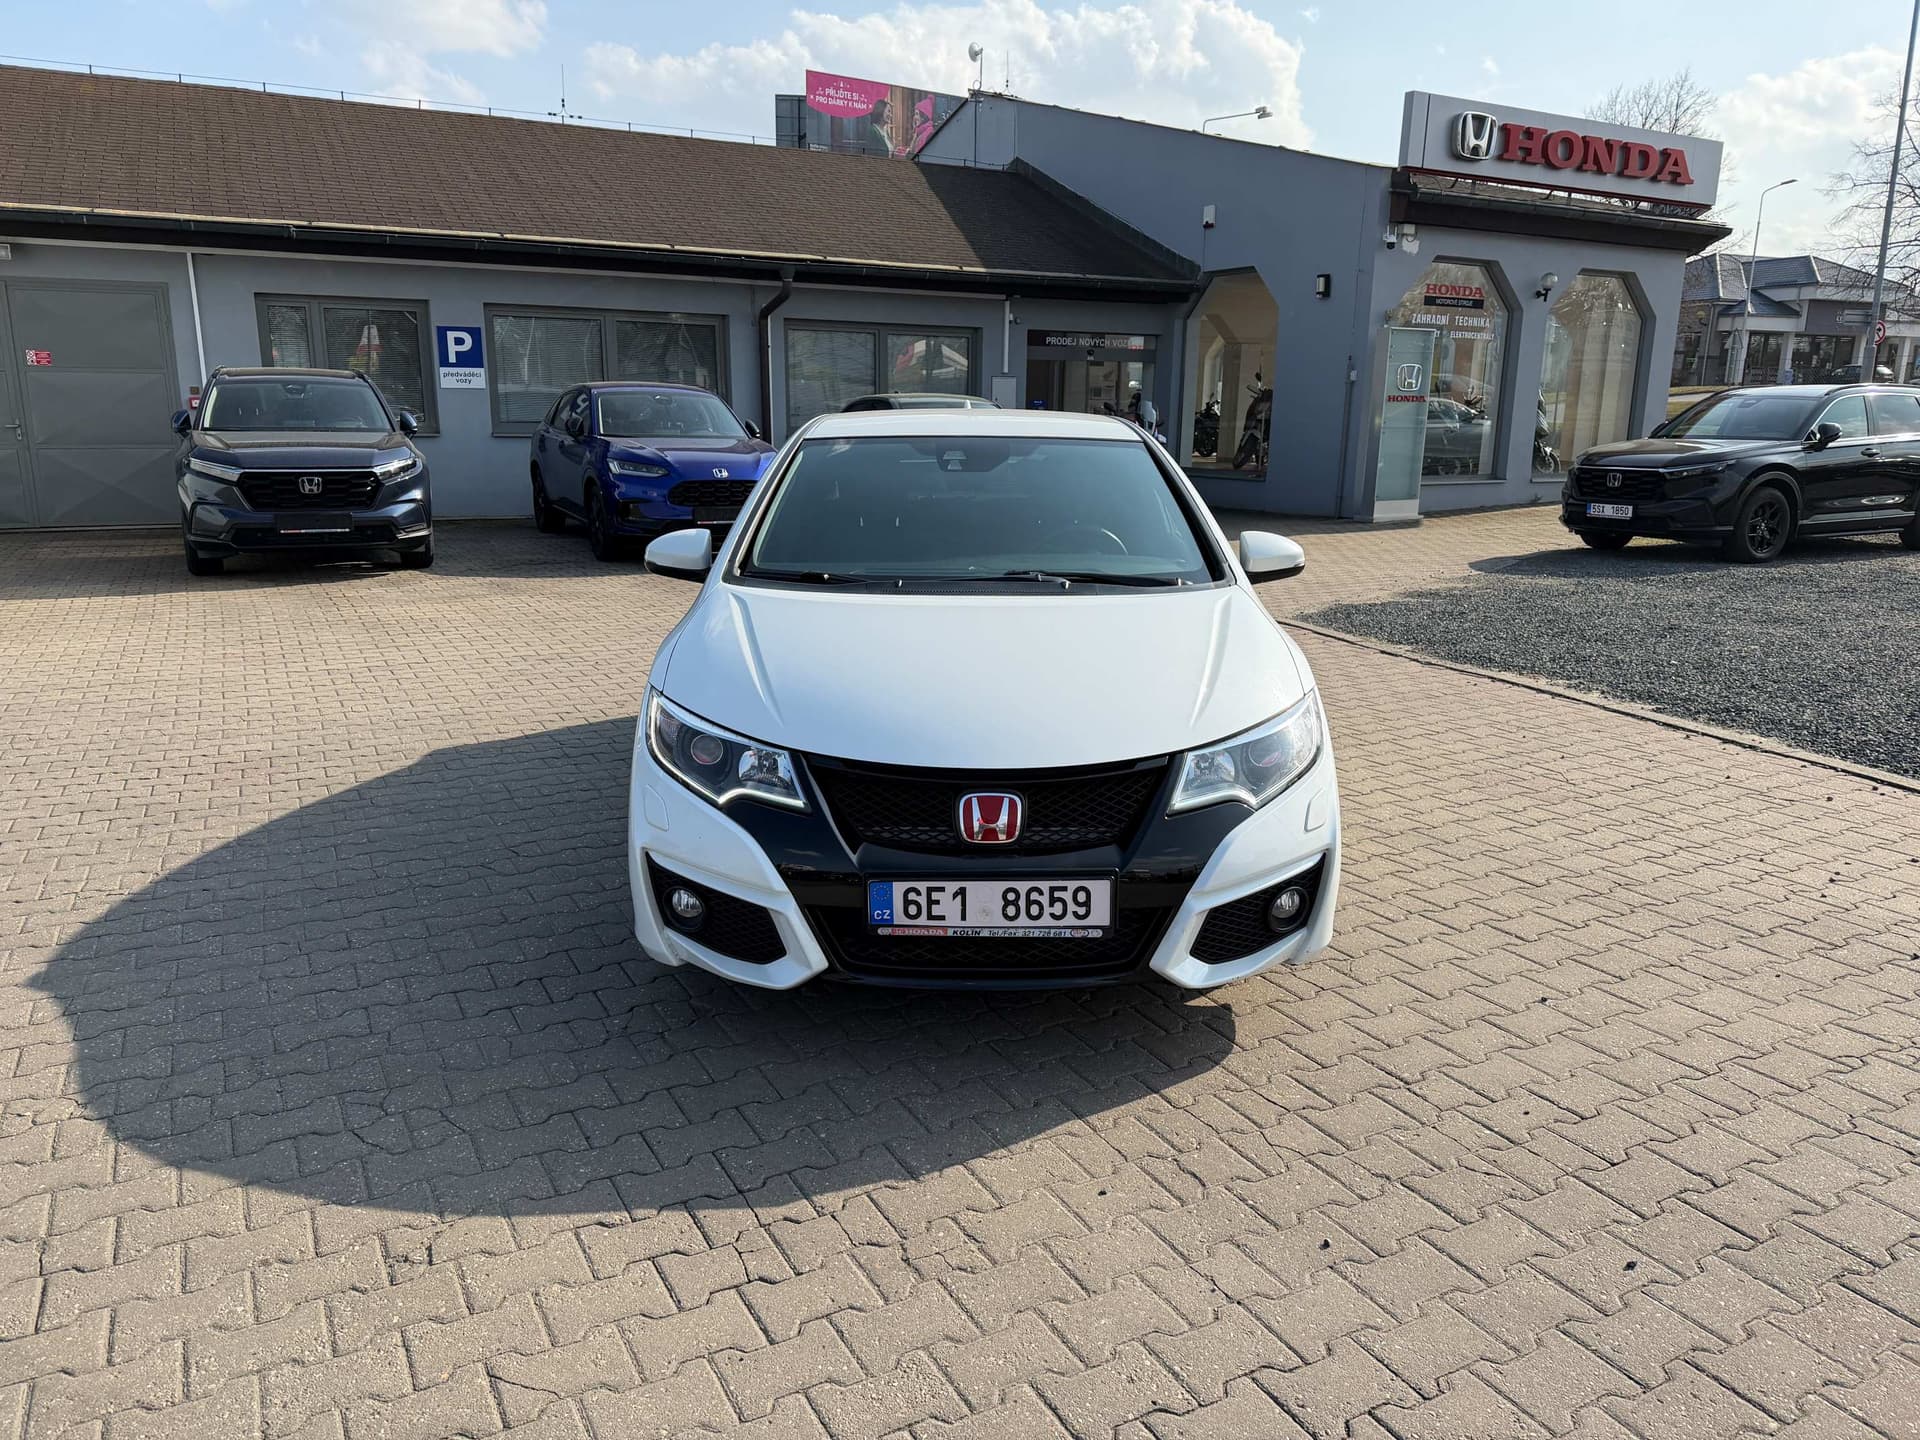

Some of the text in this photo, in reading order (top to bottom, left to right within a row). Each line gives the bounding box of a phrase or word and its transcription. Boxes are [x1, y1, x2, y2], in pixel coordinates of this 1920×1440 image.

[815, 96, 828, 104] PRO
[1501, 123, 1694, 185] HONDA
[1425, 283, 1485, 297] HONDA
[1412, 313, 1490, 328] ZAHRADNÍ TECHNIKA
[446, 331, 473, 363] P
[1046, 336, 1077, 346] PRODEJ
[1079, 336, 1111, 347] NOVÝCH
[874, 885, 1092, 922] CZ 6E1 8659
